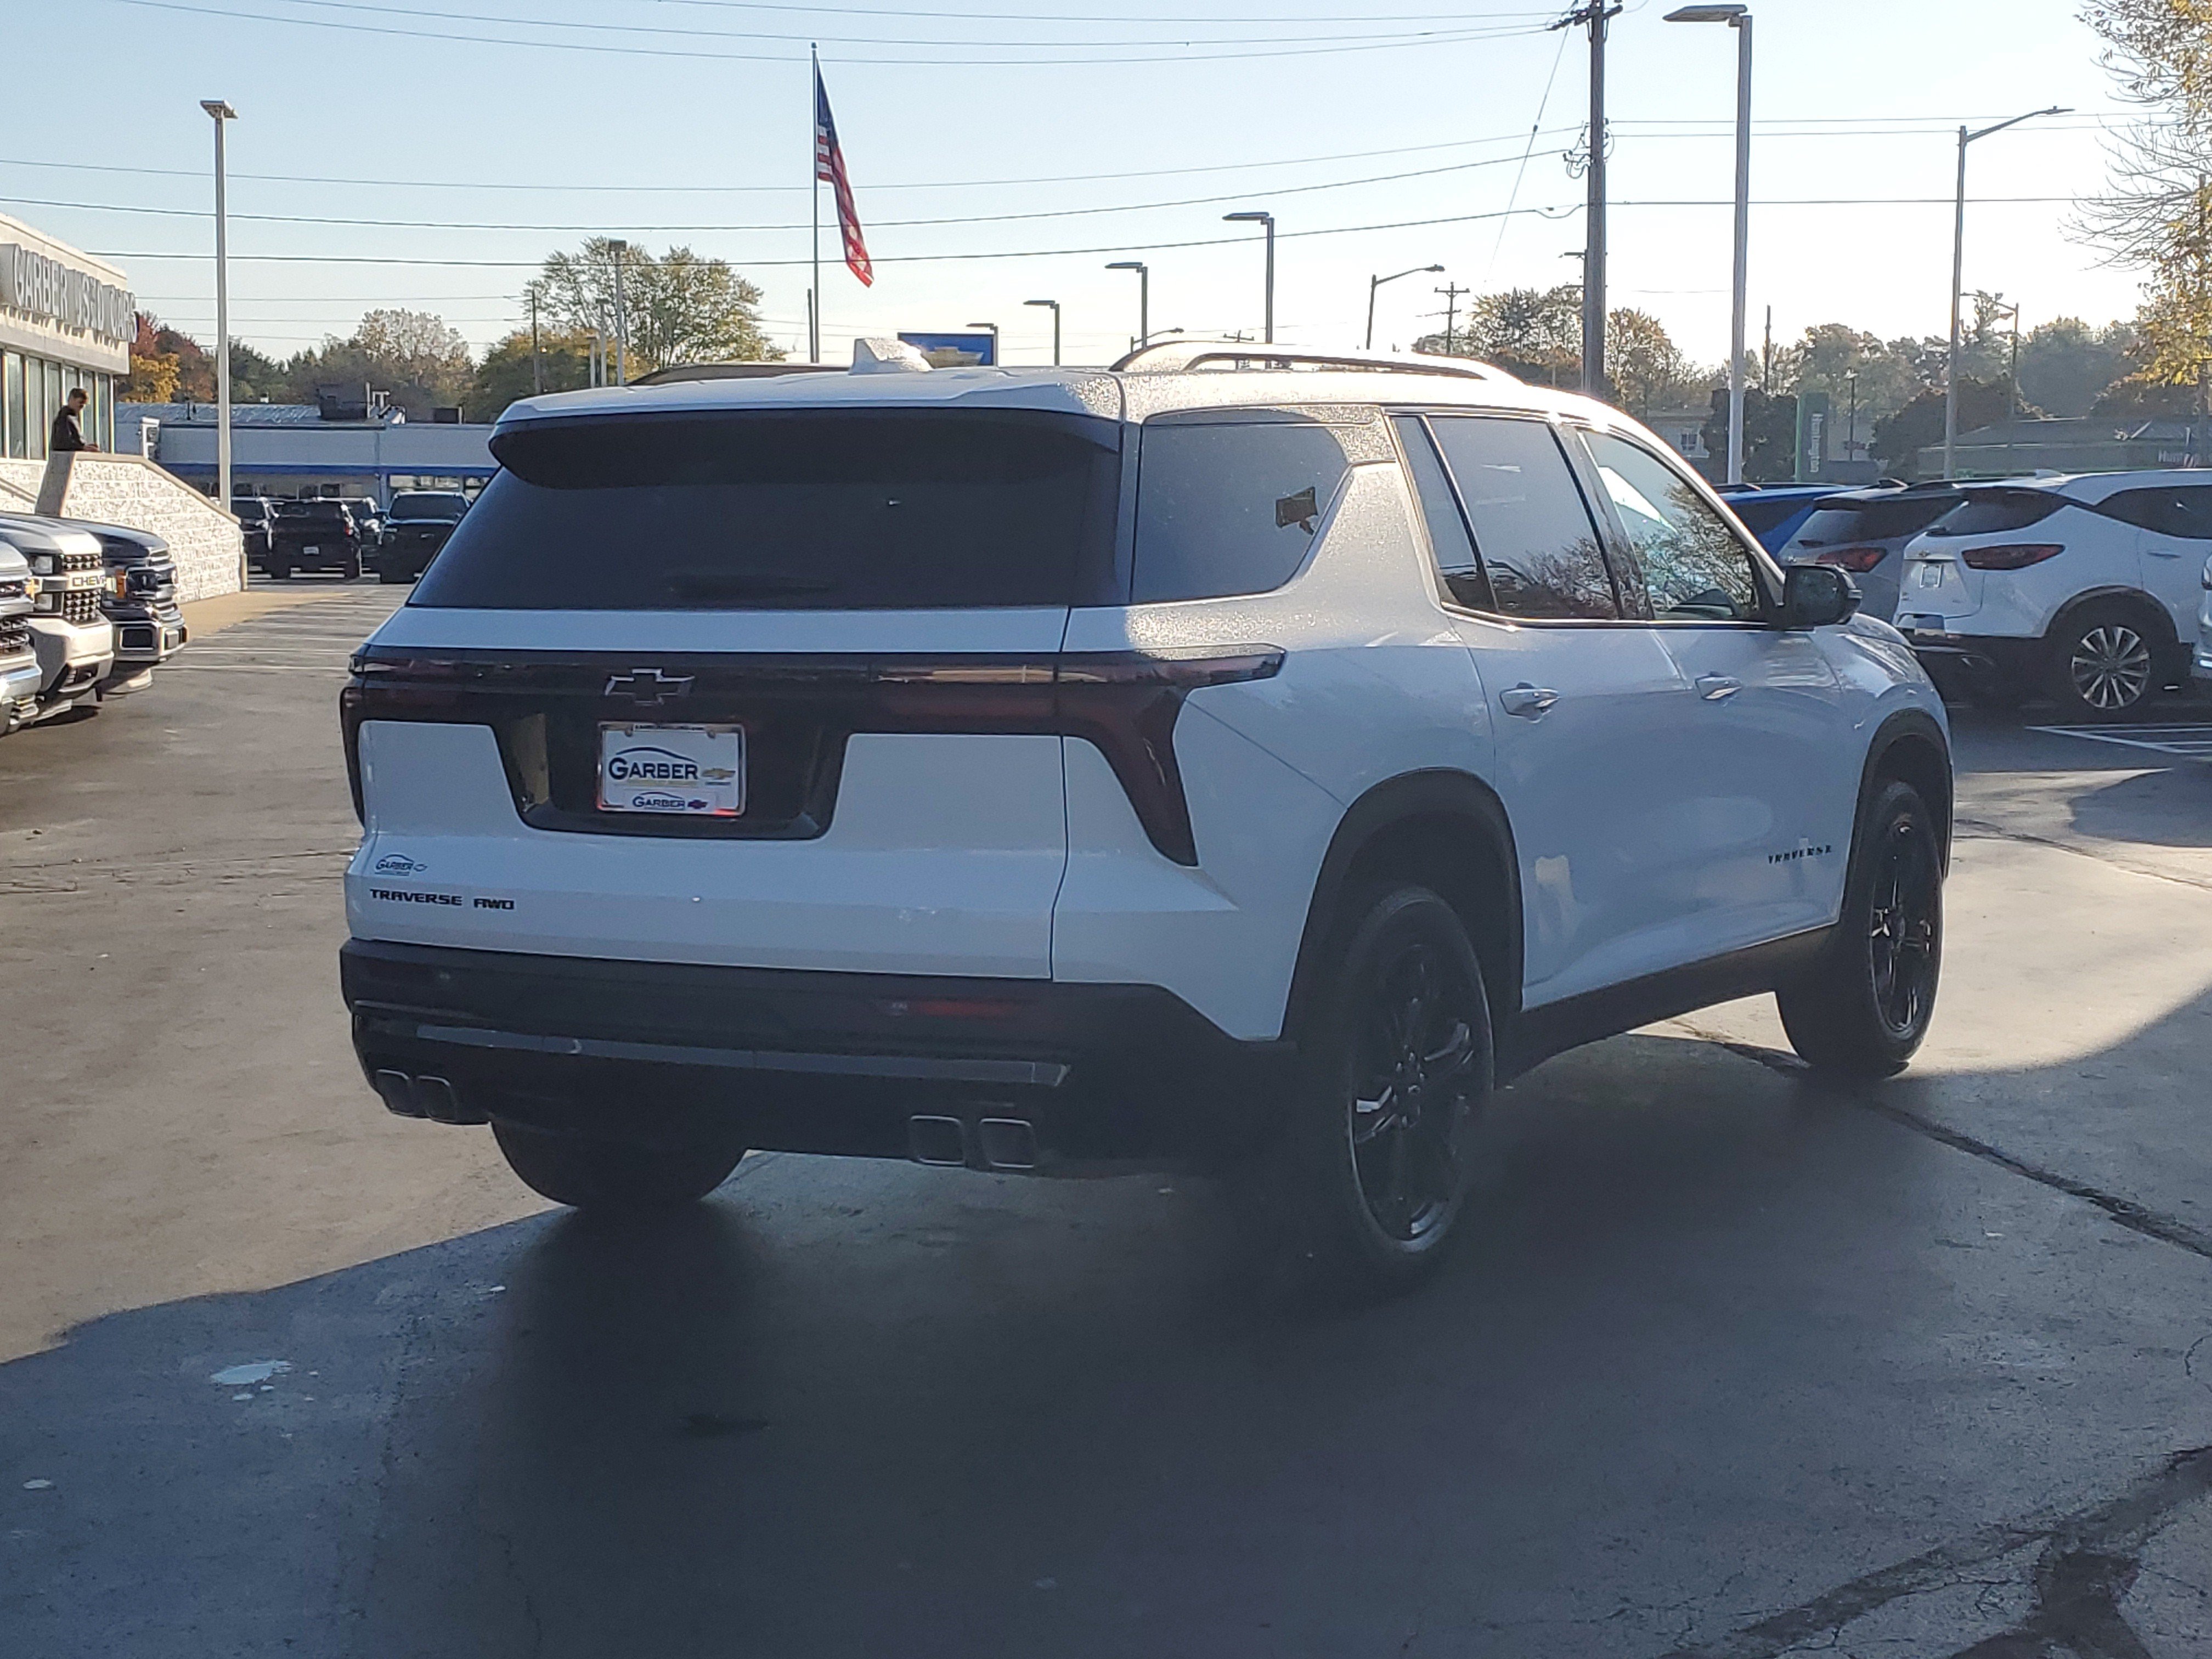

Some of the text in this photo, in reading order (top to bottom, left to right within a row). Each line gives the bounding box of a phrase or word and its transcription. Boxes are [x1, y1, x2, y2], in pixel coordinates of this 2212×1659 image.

[13, 244, 138, 343] GARBER USED CARS
[608, 757, 698, 781] GARBER
[633, 795, 685, 808] GARBER
[1768, 845, 1832, 864] TRAVERSE
[370, 888, 463, 906] TRAVERSE
